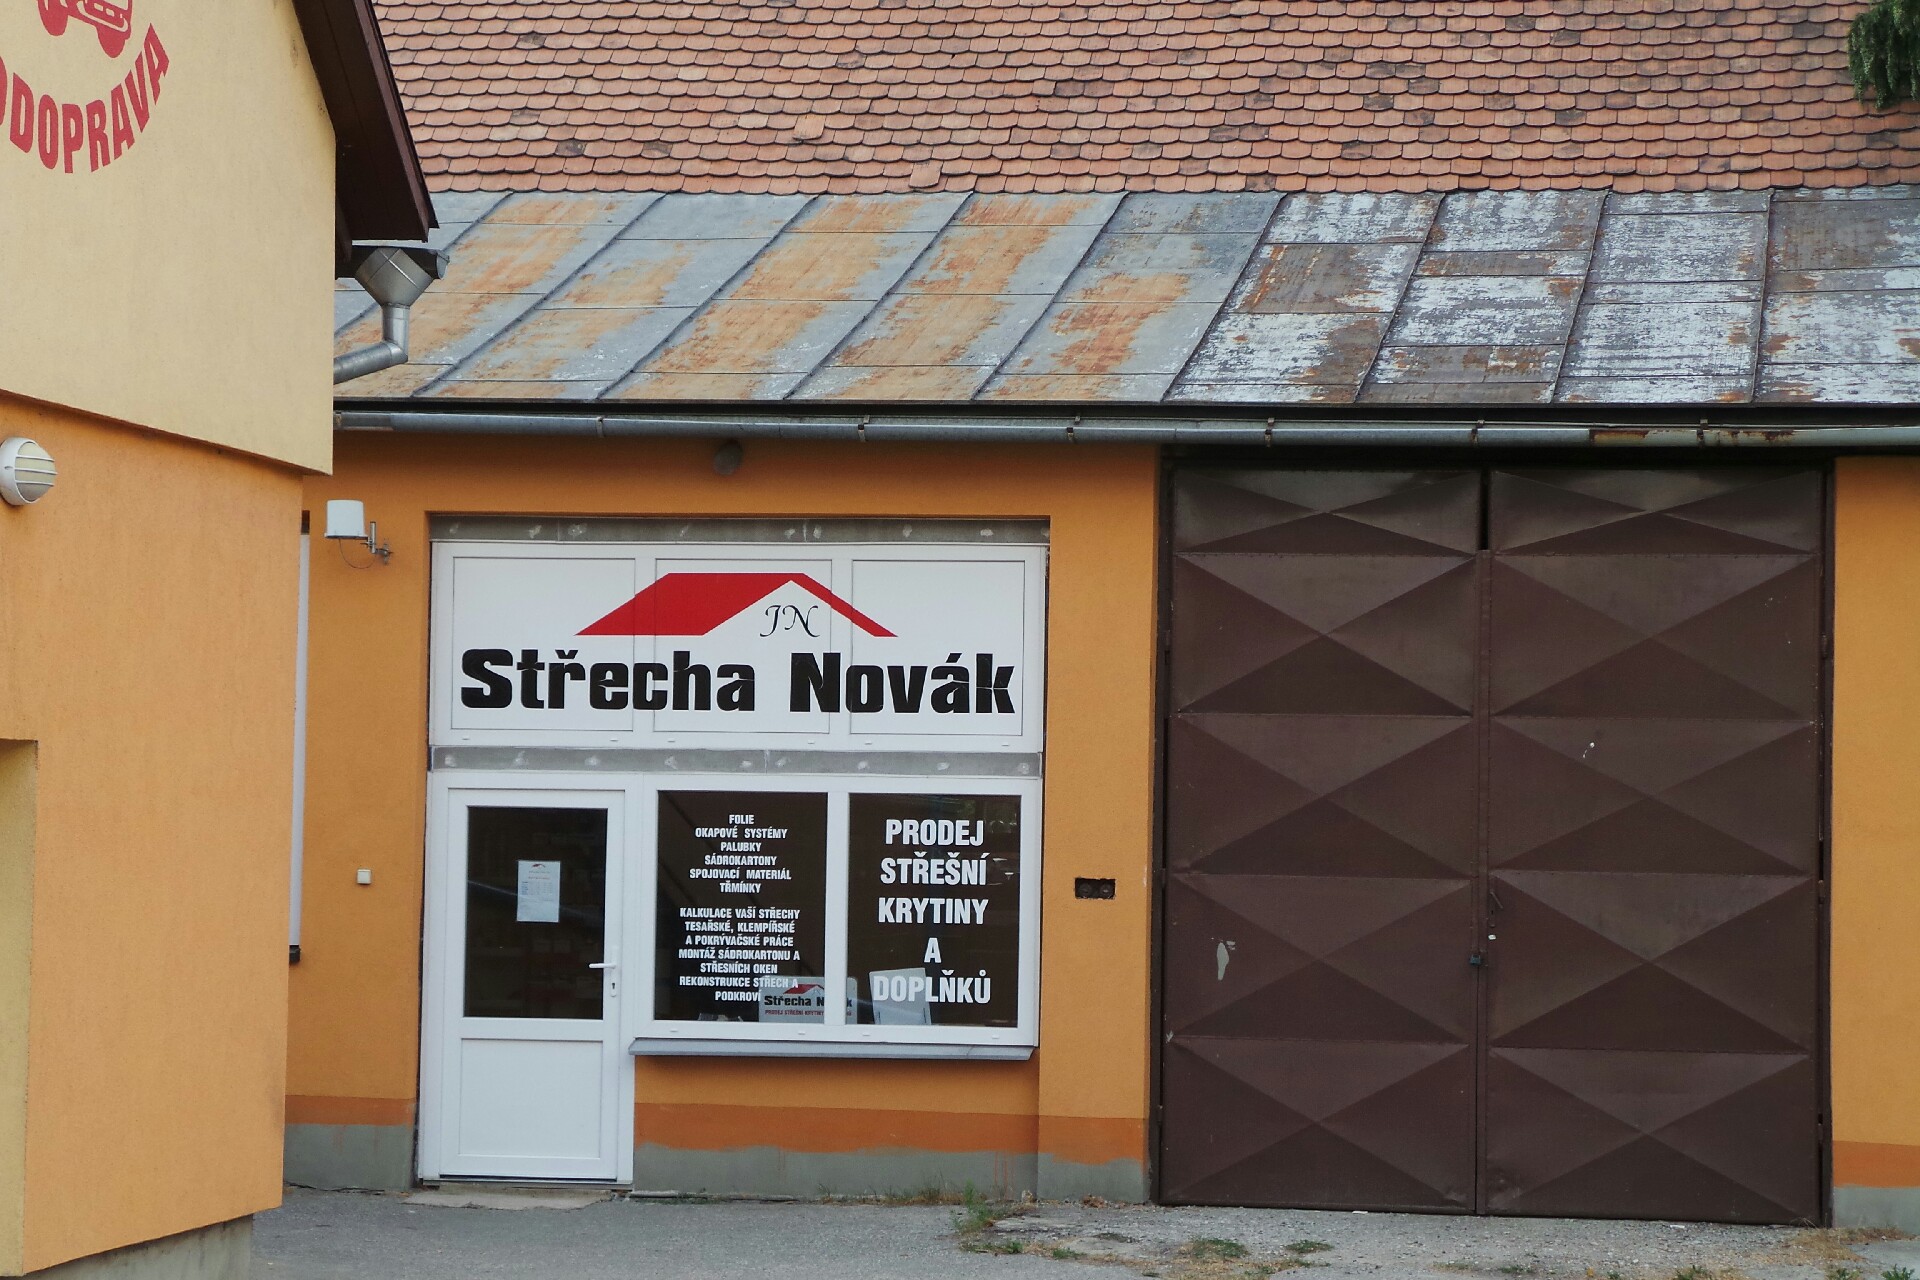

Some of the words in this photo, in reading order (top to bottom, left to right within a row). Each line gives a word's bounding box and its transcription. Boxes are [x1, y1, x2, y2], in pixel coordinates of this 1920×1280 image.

[759, 604, 821, 638] JN
[460, 648, 756, 711] Střecha
[789, 652, 1015, 715] Novák
[728, 814, 755, 825] FOLIE
[694, 826, 738, 839] OKAPOVÉ
[744, 826, 788, 839] SYSTÉMY
[885, 818, 985, 847] PRODEJ
[720, 841, 762, 852] PALUBKY
[704, 853, 777, 866] SÁDROKARTONY
[689, 867, 740, 880] SPOJOVACÍ
[746, 867, 792, 880] MATERIÁL
[880, 851, 991, 886] STŘEŠNÍ
[719, 880, 762, 894] TŘMÍNKY
[679, 907, 732, 919] KALKULACE
[735, 906, 756, 919] VAŠÍ
[758, 907, 801, 920] STŘECHY
[878, 897, 989, 925] KRYTINY
[685, 935, 693, 946] A
[694, 933, 760, 947] POKRÝVAČSKÉ
[763, 934, 794, 947] PRÁCE
[678, 946, 716, 960] MONTÁŽ
[718, 947, 791, 961] SÁDROKARTONU
[793, 950, 801, 961] A
[923, 937, 942, 963] A
[753, 963, 778, 974] OKEN
[679, 976, 750, 988] REKONSTRUKCE
[752, 974, 789, 988] STŘECH
[791, 977, 799, 989] A
[872, 969, 991, 1004] DOPLŇKŮ
[715, 988, 762, 1002] PODKROVÍ
[764, 995, 812, 1007] Střecha
